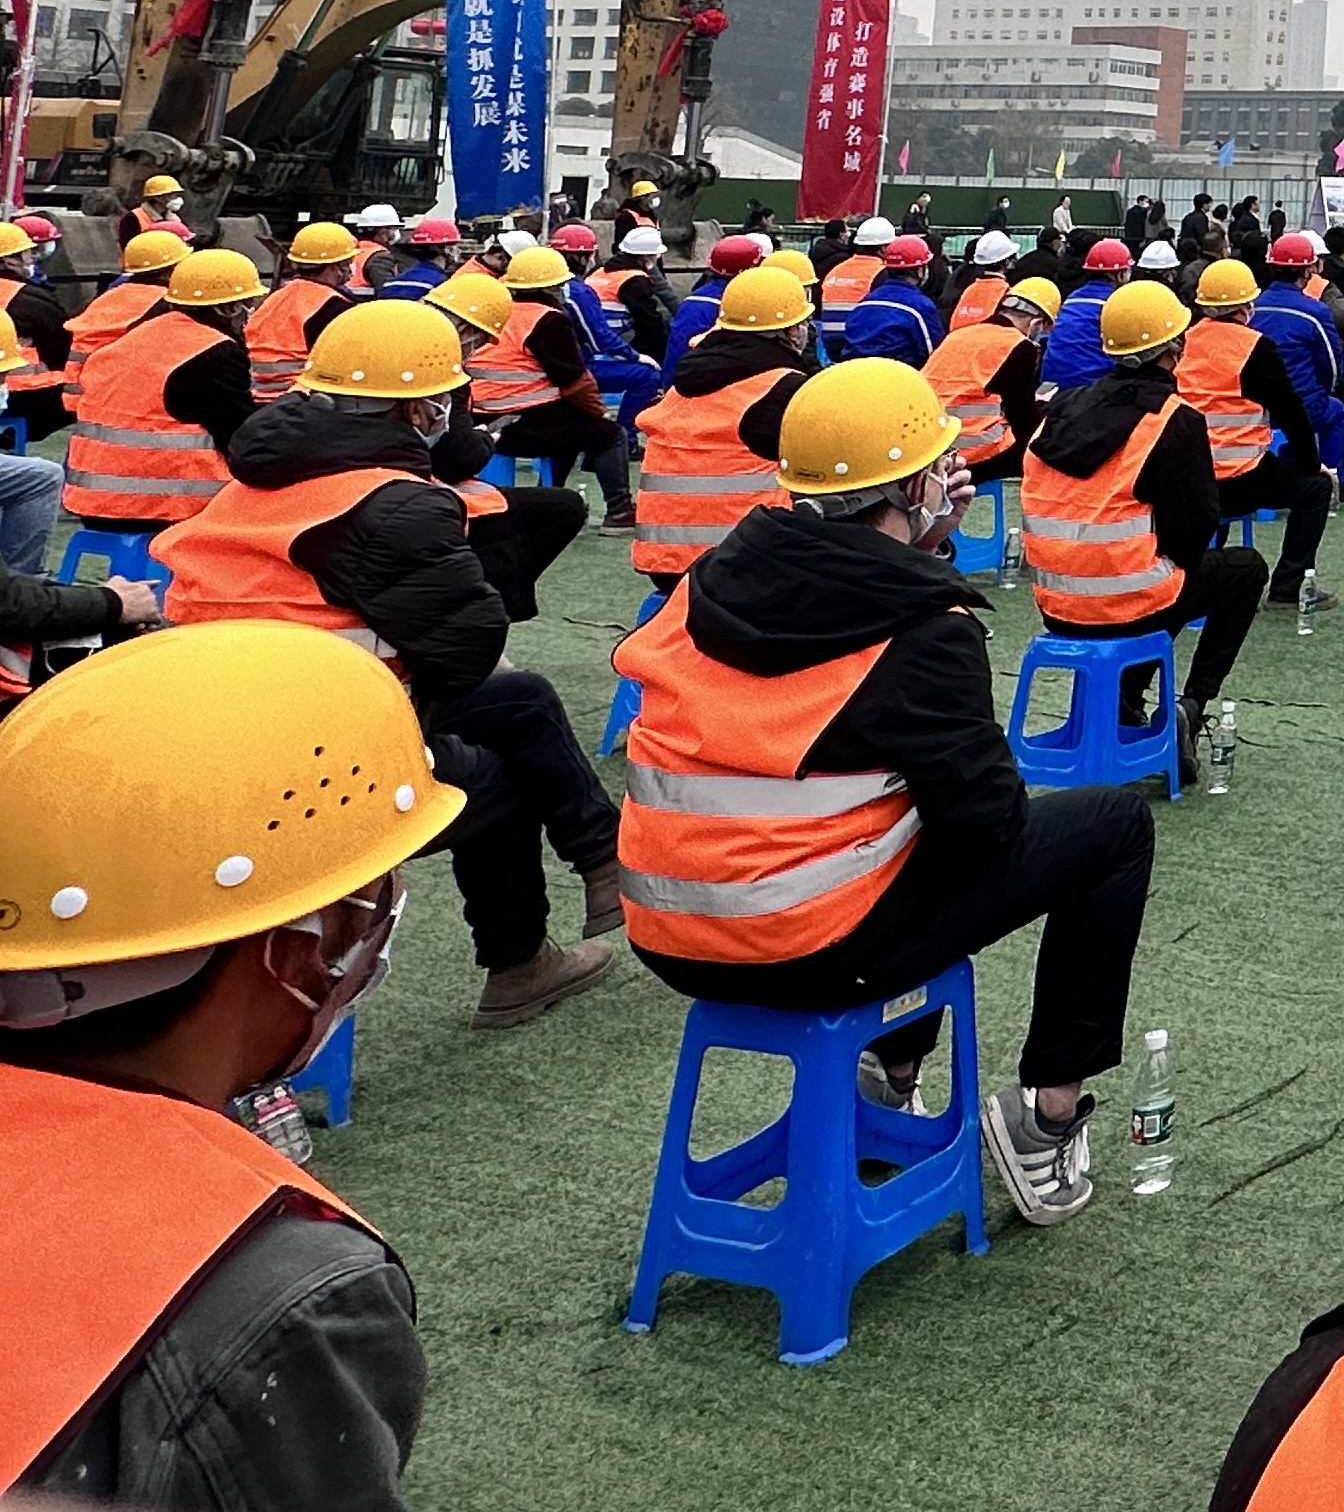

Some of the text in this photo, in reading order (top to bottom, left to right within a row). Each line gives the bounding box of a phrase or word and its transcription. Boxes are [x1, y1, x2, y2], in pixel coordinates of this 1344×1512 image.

[843, 22, 873, 172] 打造赛事名城
